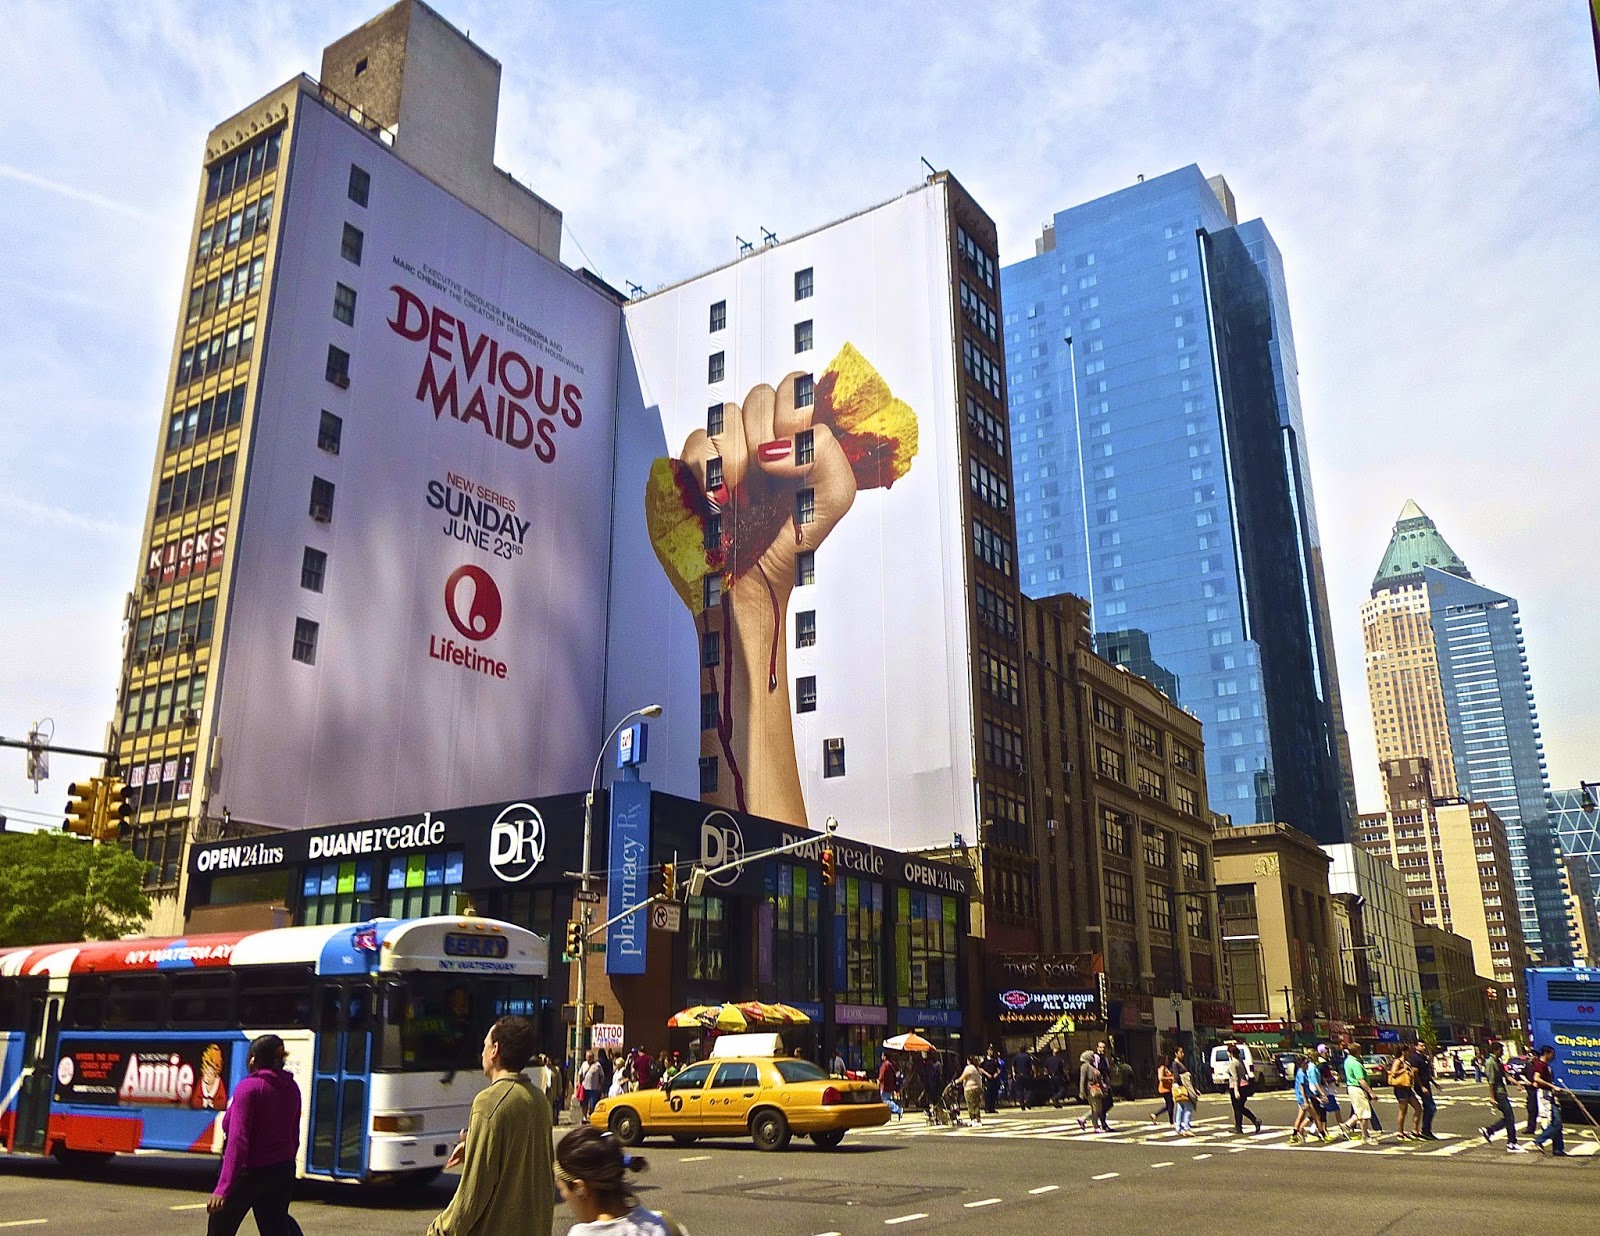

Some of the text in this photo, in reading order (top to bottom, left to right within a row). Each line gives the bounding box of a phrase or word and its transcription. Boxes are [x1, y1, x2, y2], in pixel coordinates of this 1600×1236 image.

[392, 255, 415, 275] MARC
[417, 271, 447, 293] CHERRY
[449, 289, 463, 304] THE
[463, 299, 495, 322] CREATOR
[506, 324, 544, 352] DESPERATE
[545, 347, 585, 376] HOUSEWIVES
[423, 264, 463, 293] EXECUTIVE
[464, 288, 501, 315] PRODUCER
[502, 311, 515, 325] EVA
[516, 320, 548, 345] LONGORIA
[386, 285, 583, 429] DEVIOUS
[415, 352, 557, 464] MAIDS
[426, 480, 531, 545] SUNDAY
[447, 472, 516, 512] NEW SERIES
[149, 527, 226, 569] KICKS
[443, 518, 489, 552] JUNE
[429, 634, 508, 680] Lifetime
[197, 846, 242, 872] OPEN
[782, 832, 835, 862] DUAN
[613, 834, 645, 956] pharmacy
[904, 862, 937, 887] OPEN
[1034, 994, 1065, 1003] HAPPY
[1068, 994, 1094, 1003] HOUR
[1043, 1002, 1086, 1010] ALL DAY!
[594, 1026, 622, 1038] TATTOO
[121, 1052, 194, 1101] Annie
